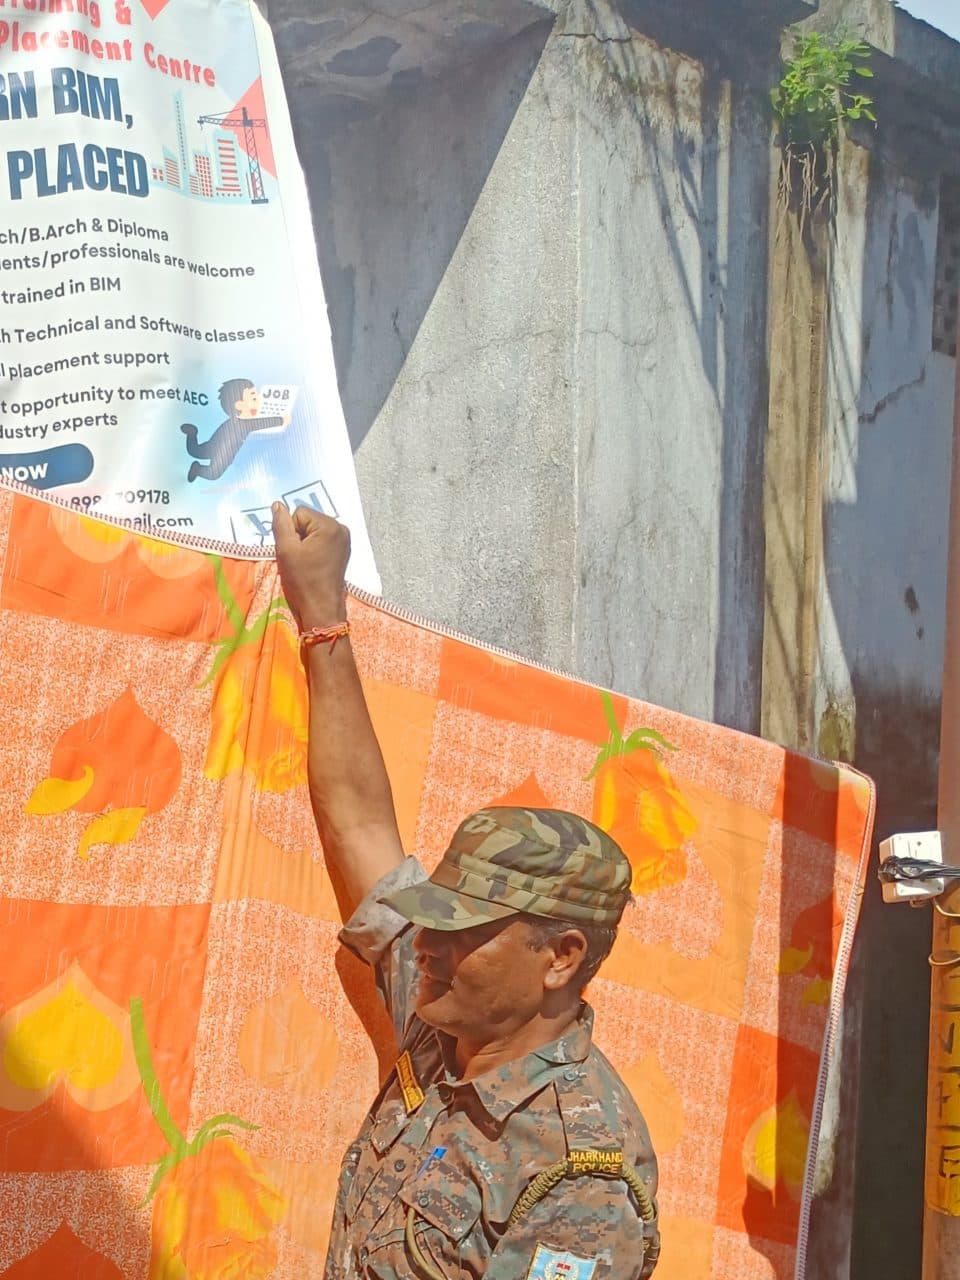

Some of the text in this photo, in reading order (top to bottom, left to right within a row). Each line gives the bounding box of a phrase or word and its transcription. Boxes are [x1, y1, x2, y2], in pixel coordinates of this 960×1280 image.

[143, 42, 216, 87] Centre
[51, 67, 133, 129] BIM,
[7, 143, 150, 201] PLACED
[91, 218, 103, 232] &
[107, 218, 169, 242] Diploma
[164, 253, 186, 269] are
[187, 261, 256, 278] welcome
[1, 282, 65, 304] trained
[69, 278, 86, 294] in
[90, 277, 121, 291] BIM
[14, 315, 99, 343] Technical
[104, 315, 136, 330] and
[140, 316, 202, 341] Software
[204, 327, 266, 343] classes
[9, 351, 100, 381] placement
[103, 350, 171, 368] support
[10, 386, 114, 417] opportunity
[117, 387, 136, 401] to
[139, 387, 181, 401] meet
[183, 391, 209, 407] AEC
[262, 388, 290, 401] JOB
[52, 412, 118, 434] experts
[1, 462, 48, 481] NOW
[567, 1151, 624, 1163] JHARKHAND
[573, 1163, 620, 1174] POLICE
